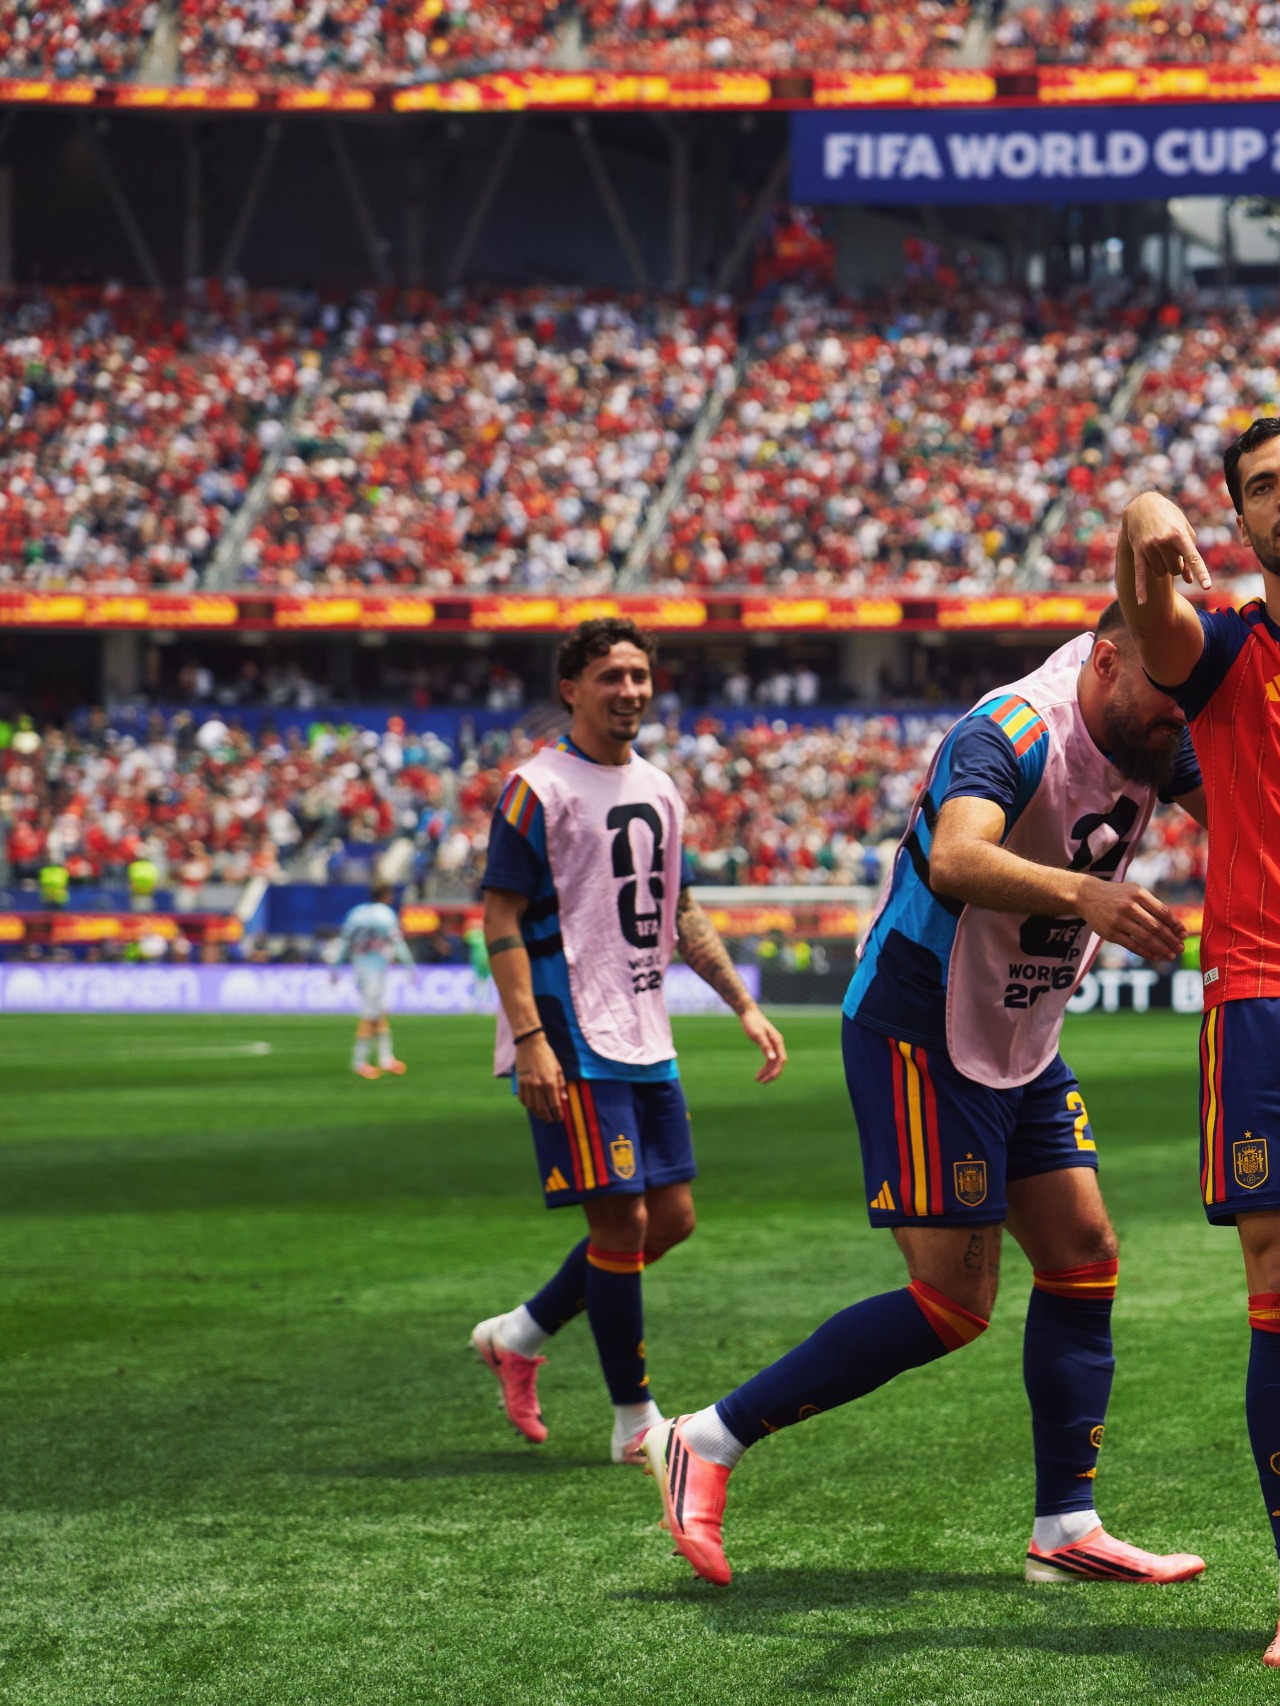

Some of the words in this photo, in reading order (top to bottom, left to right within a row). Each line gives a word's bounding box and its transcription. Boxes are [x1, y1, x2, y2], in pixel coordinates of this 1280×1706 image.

[824, 134, 943, 179] FIFA
[948, 132, 1147, 177] WORLD
[1155, 128, 1265, 175] CUP
[1044, 924, 1080, 944] FIF
[1008, 963, 1056, 981] WOR
[1065, 1090, 1097, 1152] 2
